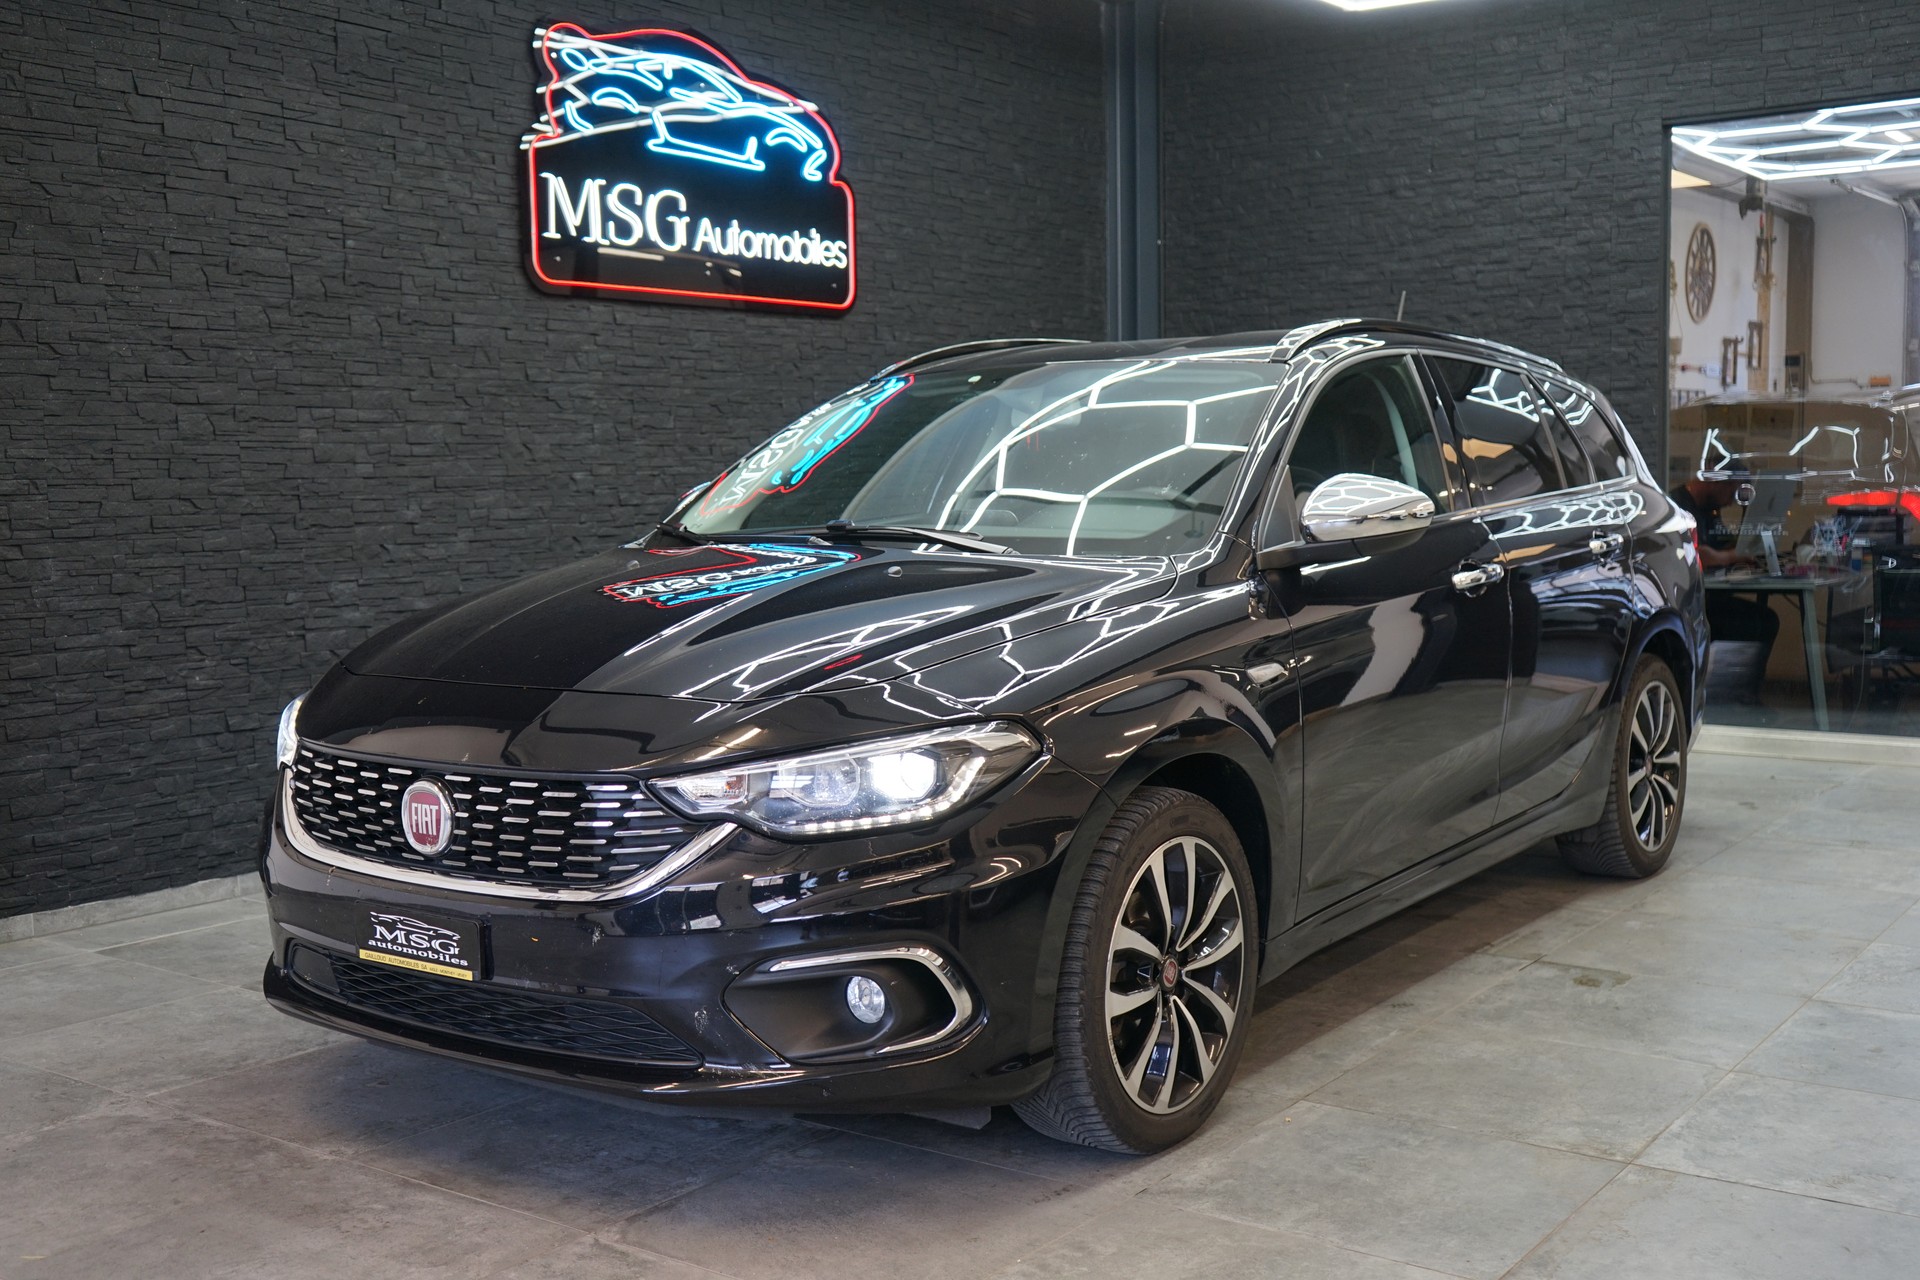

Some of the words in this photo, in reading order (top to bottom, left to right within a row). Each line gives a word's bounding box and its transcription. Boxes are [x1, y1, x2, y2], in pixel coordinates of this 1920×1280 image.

[539, 172, 690, 252] MSG
[693, 217, 848, 269] Automobiles
[411, 802, 439, 836] FIAT
[368, 939, 468, 966] automobiles
[373, 925, 460, 955] MSG
[388, 956, 420, 968] AUTOMOBILES
